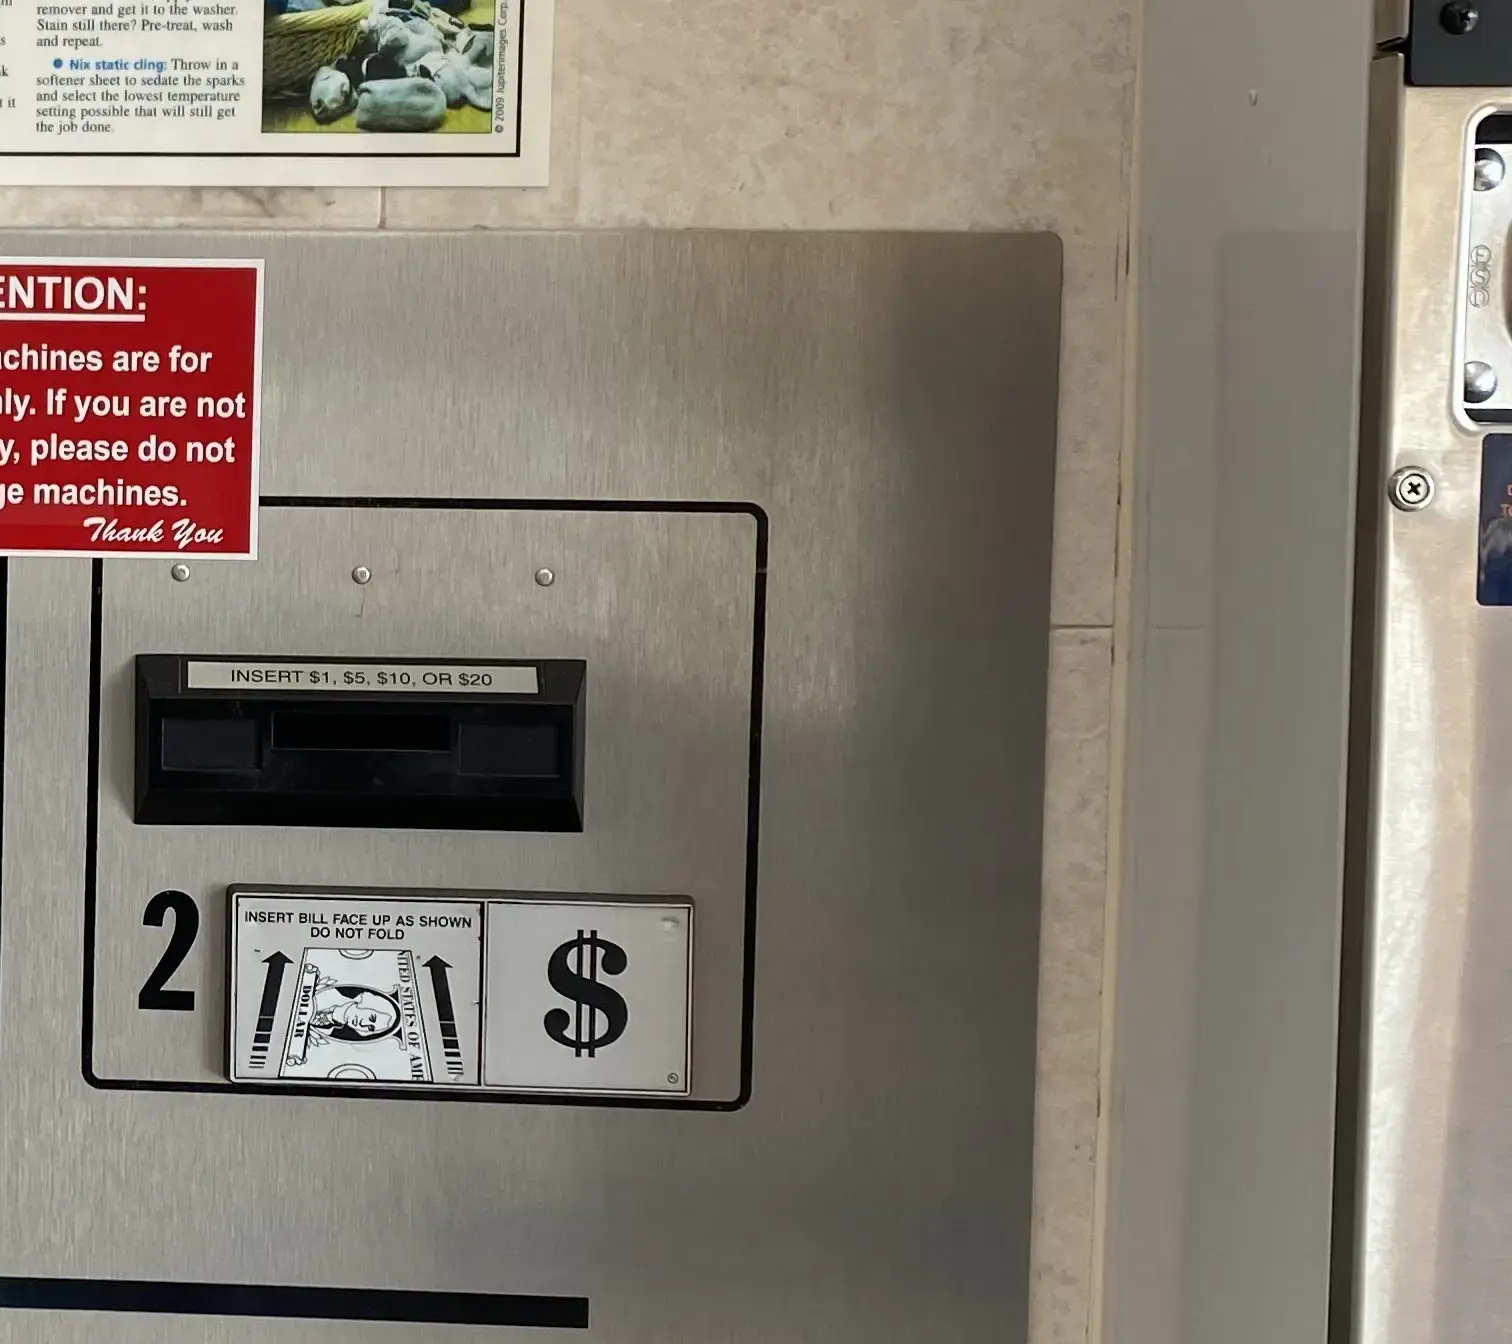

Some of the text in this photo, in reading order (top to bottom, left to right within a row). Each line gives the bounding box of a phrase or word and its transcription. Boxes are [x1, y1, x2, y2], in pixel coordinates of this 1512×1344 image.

[69, 58, 239, 74] Nix static cling: Throw in a
[36, 120, 114, 135] the job done.
[112, 351, 160, 372] are
[168, 345, 212, 373] for
[47, 388, 67, 415] If
[74, 395, 129, 423] you
[140, 396, 187, 417] are
[197, 392, 246, 418] not
[31, 433, 128, 466] please
[138, 434, 176, 462] do
[186, 437, 235, 463] not
[34, 478, 187, 506] machines.
[83, 517, 223, 549] Thank You
[232, 669, 492, 687] INSERT $1, $5, $10, OR $20
[245, 911, 472, 928] INSERT BILL FACE UP AS SHOWN
[311, 927, 404, 940] DO NOT FOLD
[138, 890, 199, 1011] 2
[294, 985, 312, 1038] DOLLAR
[402, 986, 416, 1028] STATES
[408, 1030, 421, 1050] OF
